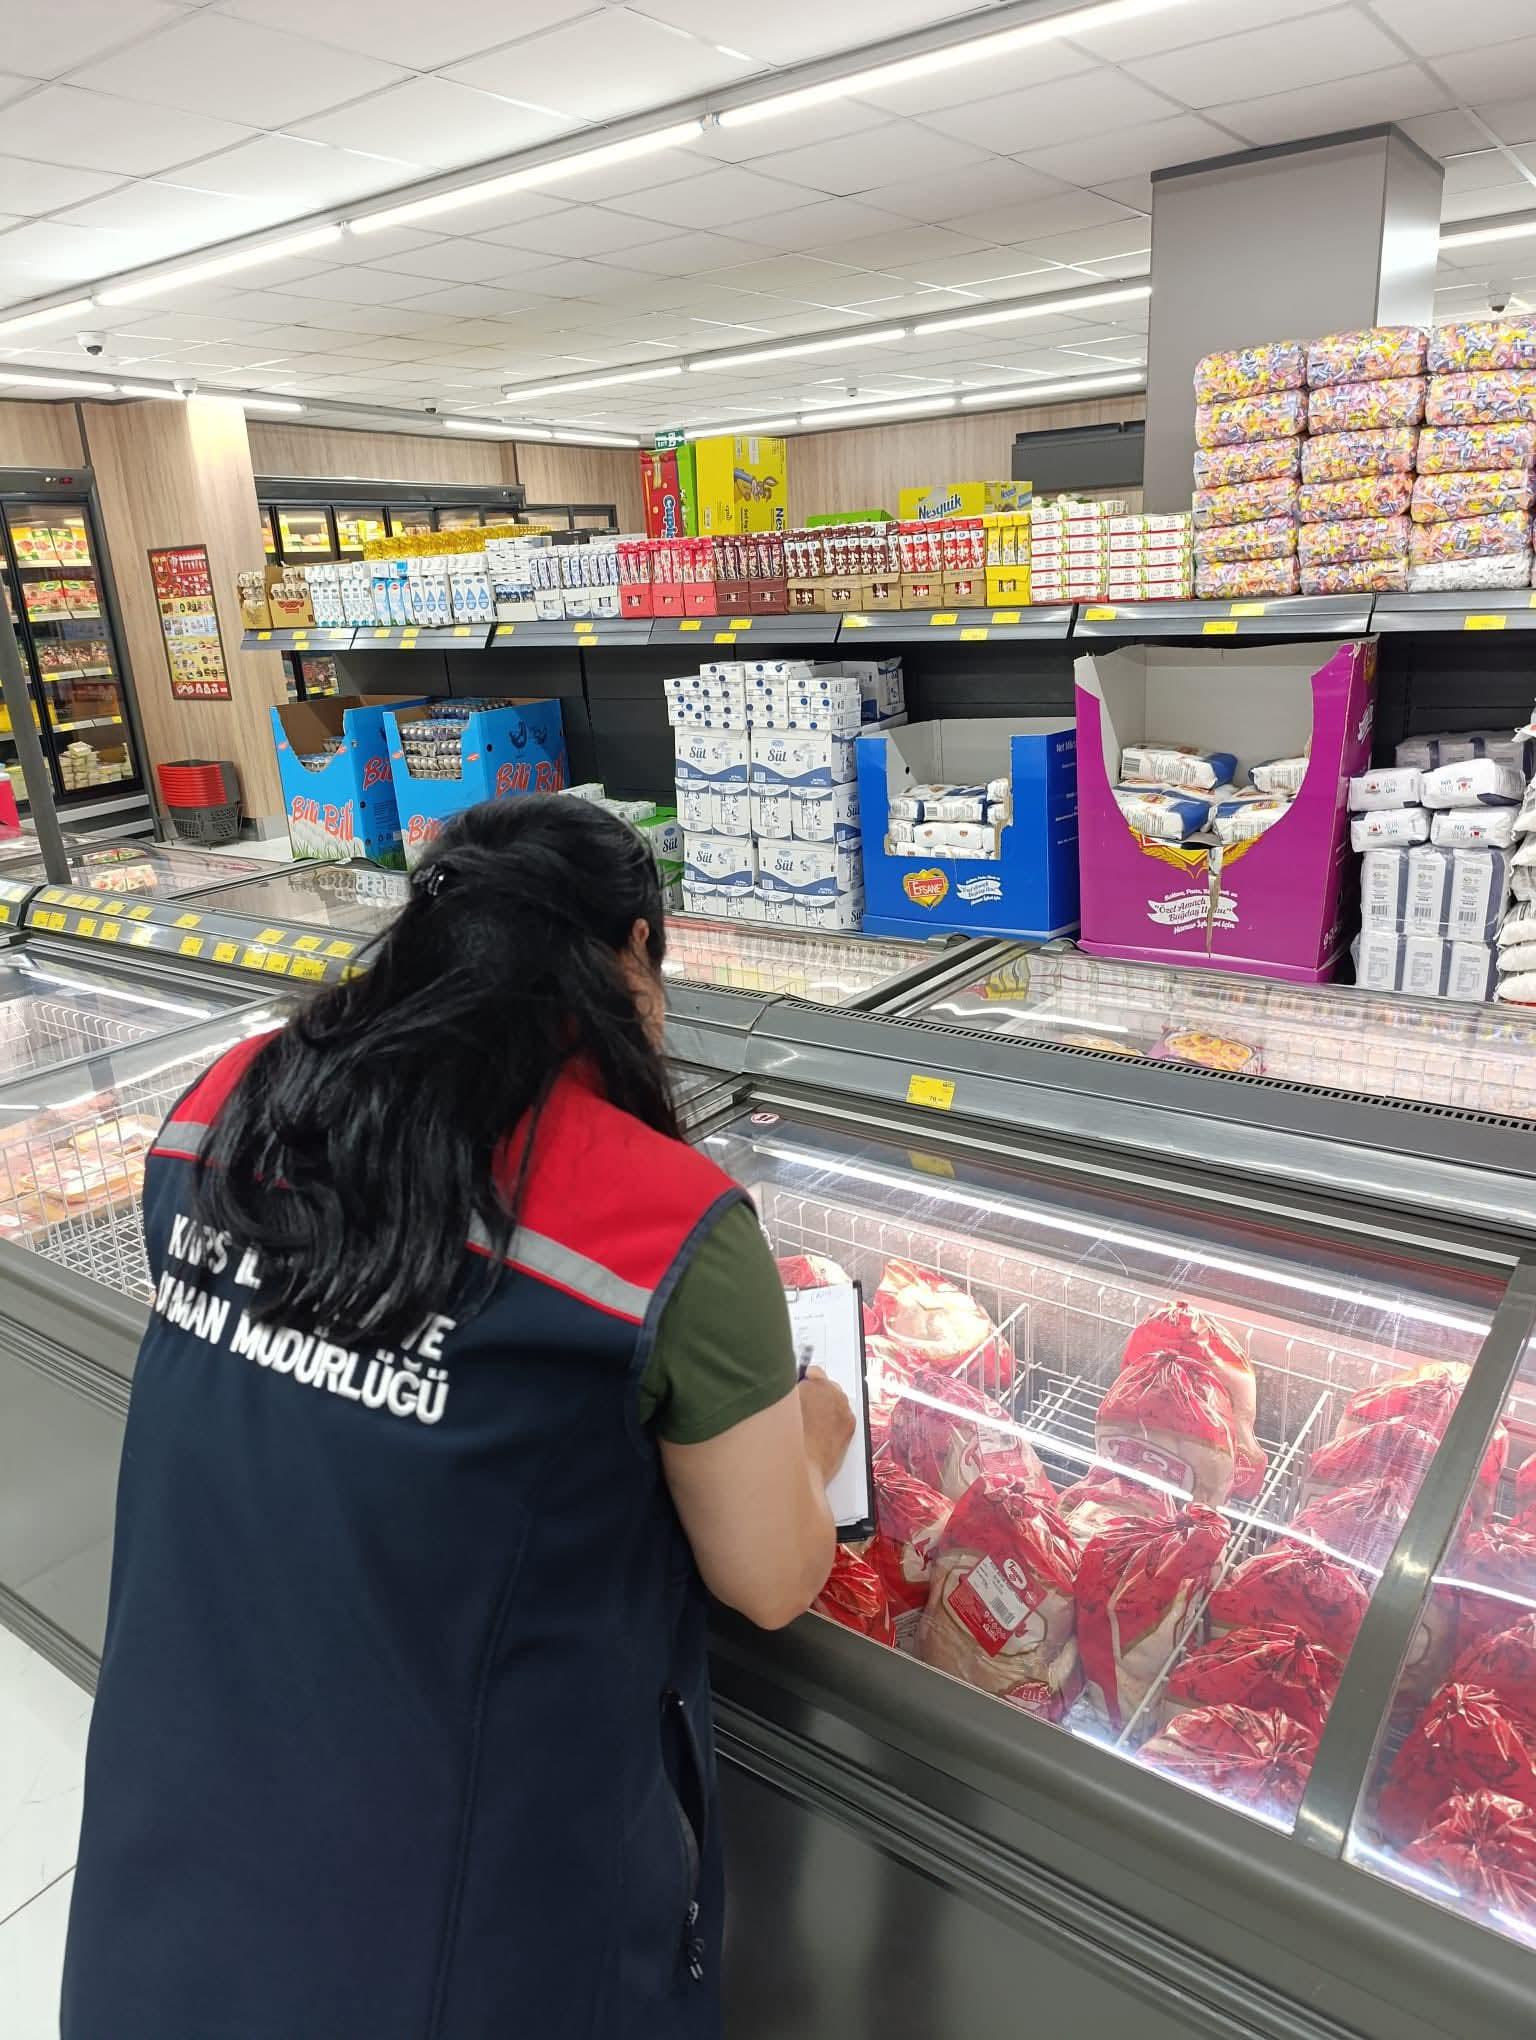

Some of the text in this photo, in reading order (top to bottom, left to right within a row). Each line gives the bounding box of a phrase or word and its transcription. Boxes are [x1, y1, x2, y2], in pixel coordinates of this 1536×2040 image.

[689, 746, 708, 760] Süt
[767, 749, 788, 763] Süt
[662, 836, 679, 853] Süt
[696, 850, 713, 864] Süt
[774, 857, 794, 872] Süt
[912, 881, 942, 896] EFSANE
